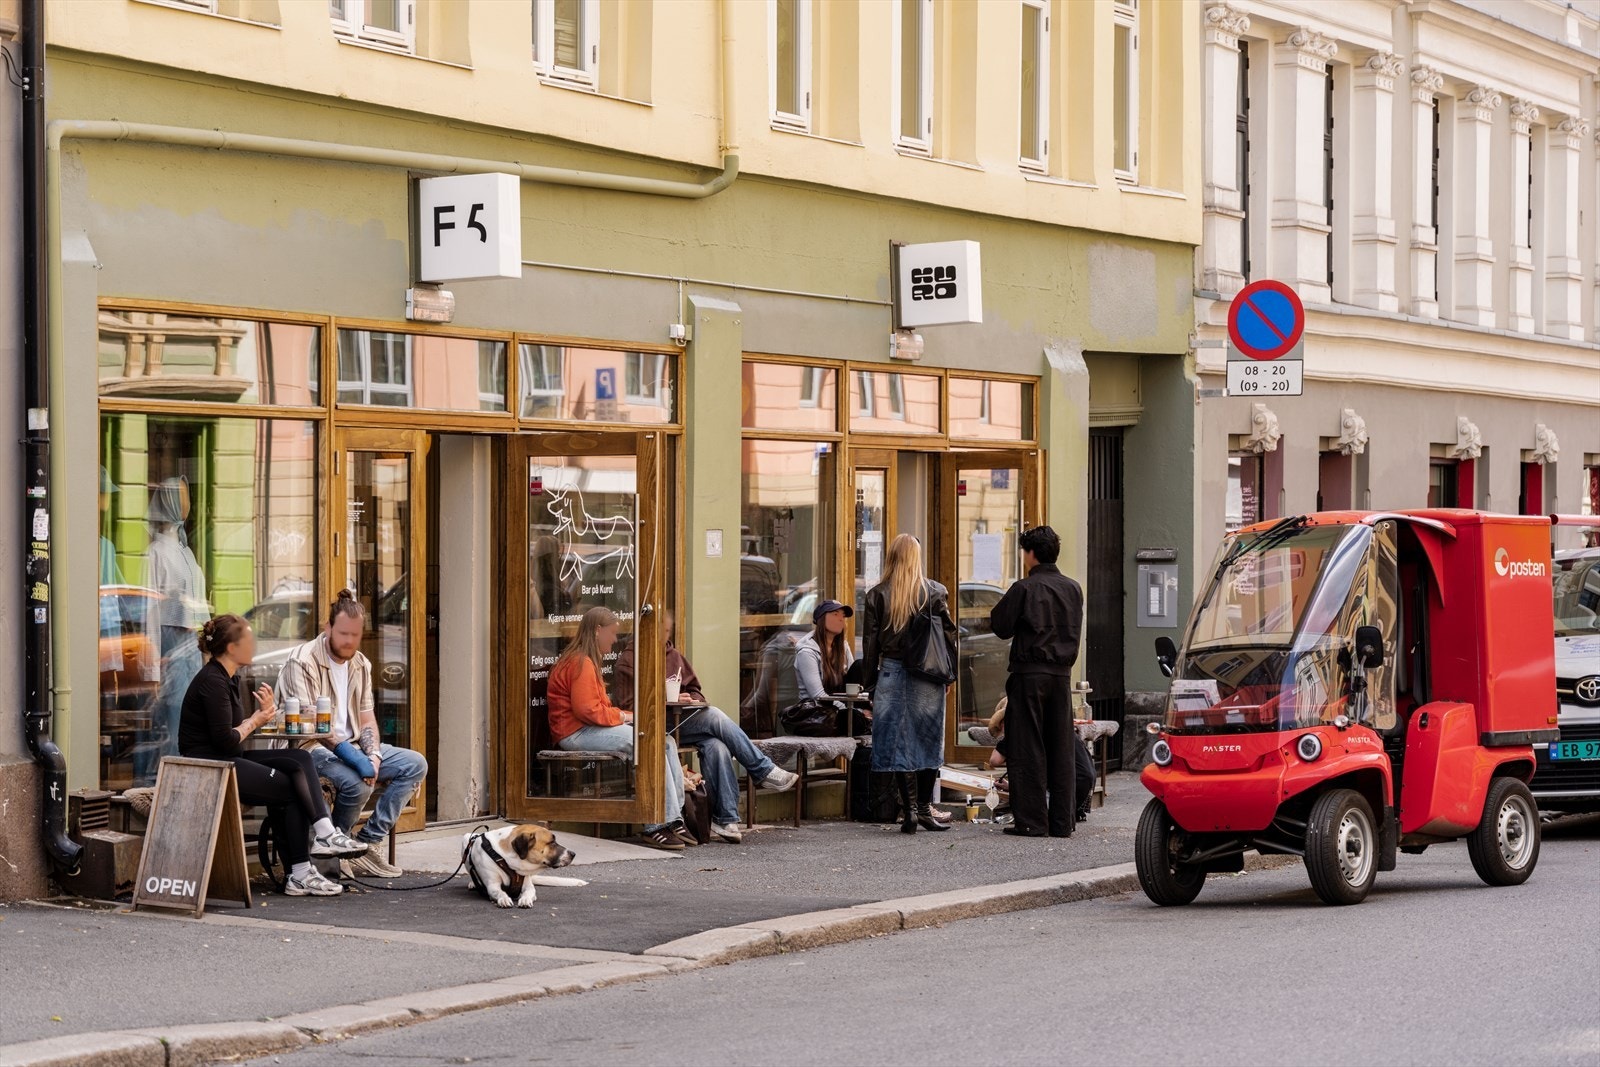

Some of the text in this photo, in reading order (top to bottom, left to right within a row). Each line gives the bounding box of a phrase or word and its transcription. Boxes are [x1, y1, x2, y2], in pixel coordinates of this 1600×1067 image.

[1244, 365, 1259, 376] 08
[1272, 365, 1286, 376] 20
[1240, 379, 1258, 392] (09
[1271, 379, 1290, 392] 20)
[1509, 558, 1546, 580] posten
[581, 584, 592, 595] Bar
[592, 584, 599, 596] på
[599, 584, 613, 594] Kuro!
[548, 613, 565, 625] Kjære
[531, 655, 544, 667] Følg
[544, 656, 554, 664] oss
[1562, 743, 1579, 757] EB
[145, 876, 197, 897] OPEN
